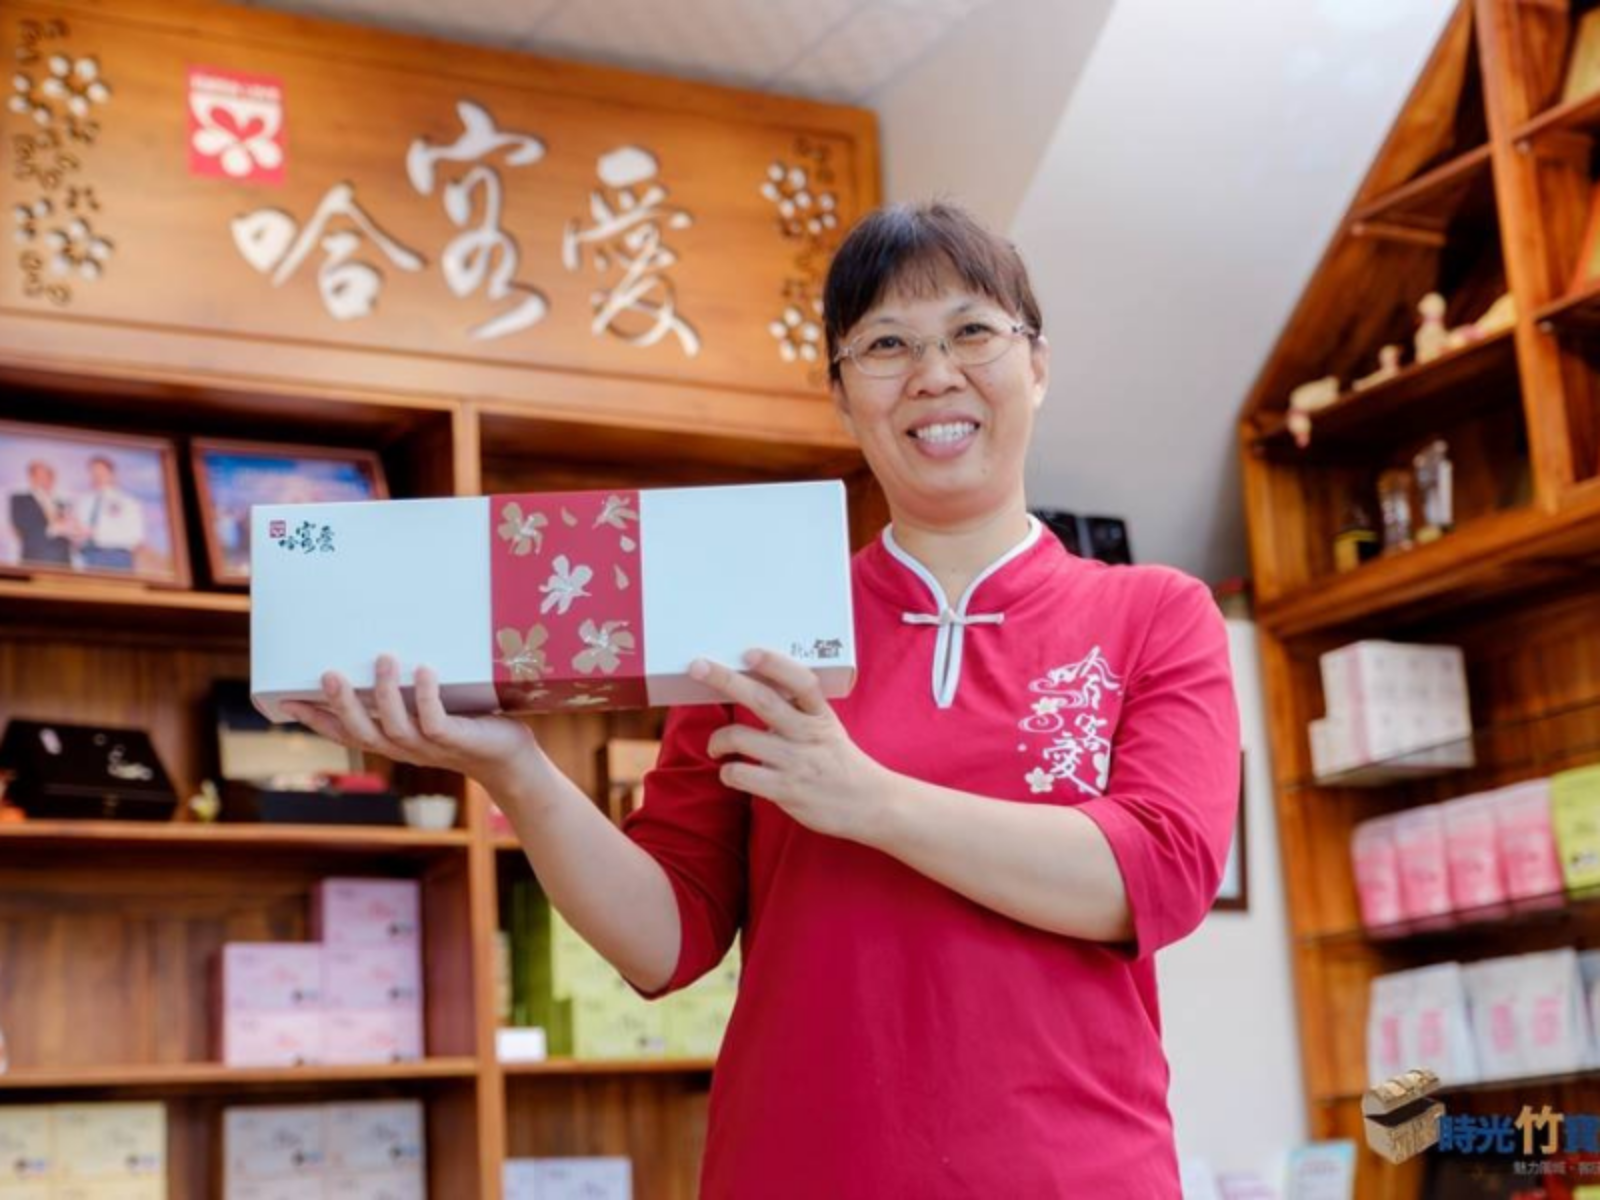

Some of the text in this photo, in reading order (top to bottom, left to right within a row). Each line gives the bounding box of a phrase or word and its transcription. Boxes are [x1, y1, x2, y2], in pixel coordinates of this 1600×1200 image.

[230, 99, 702, 358] 哈客愛
[278, 520, 336, 555] 哈客愛
